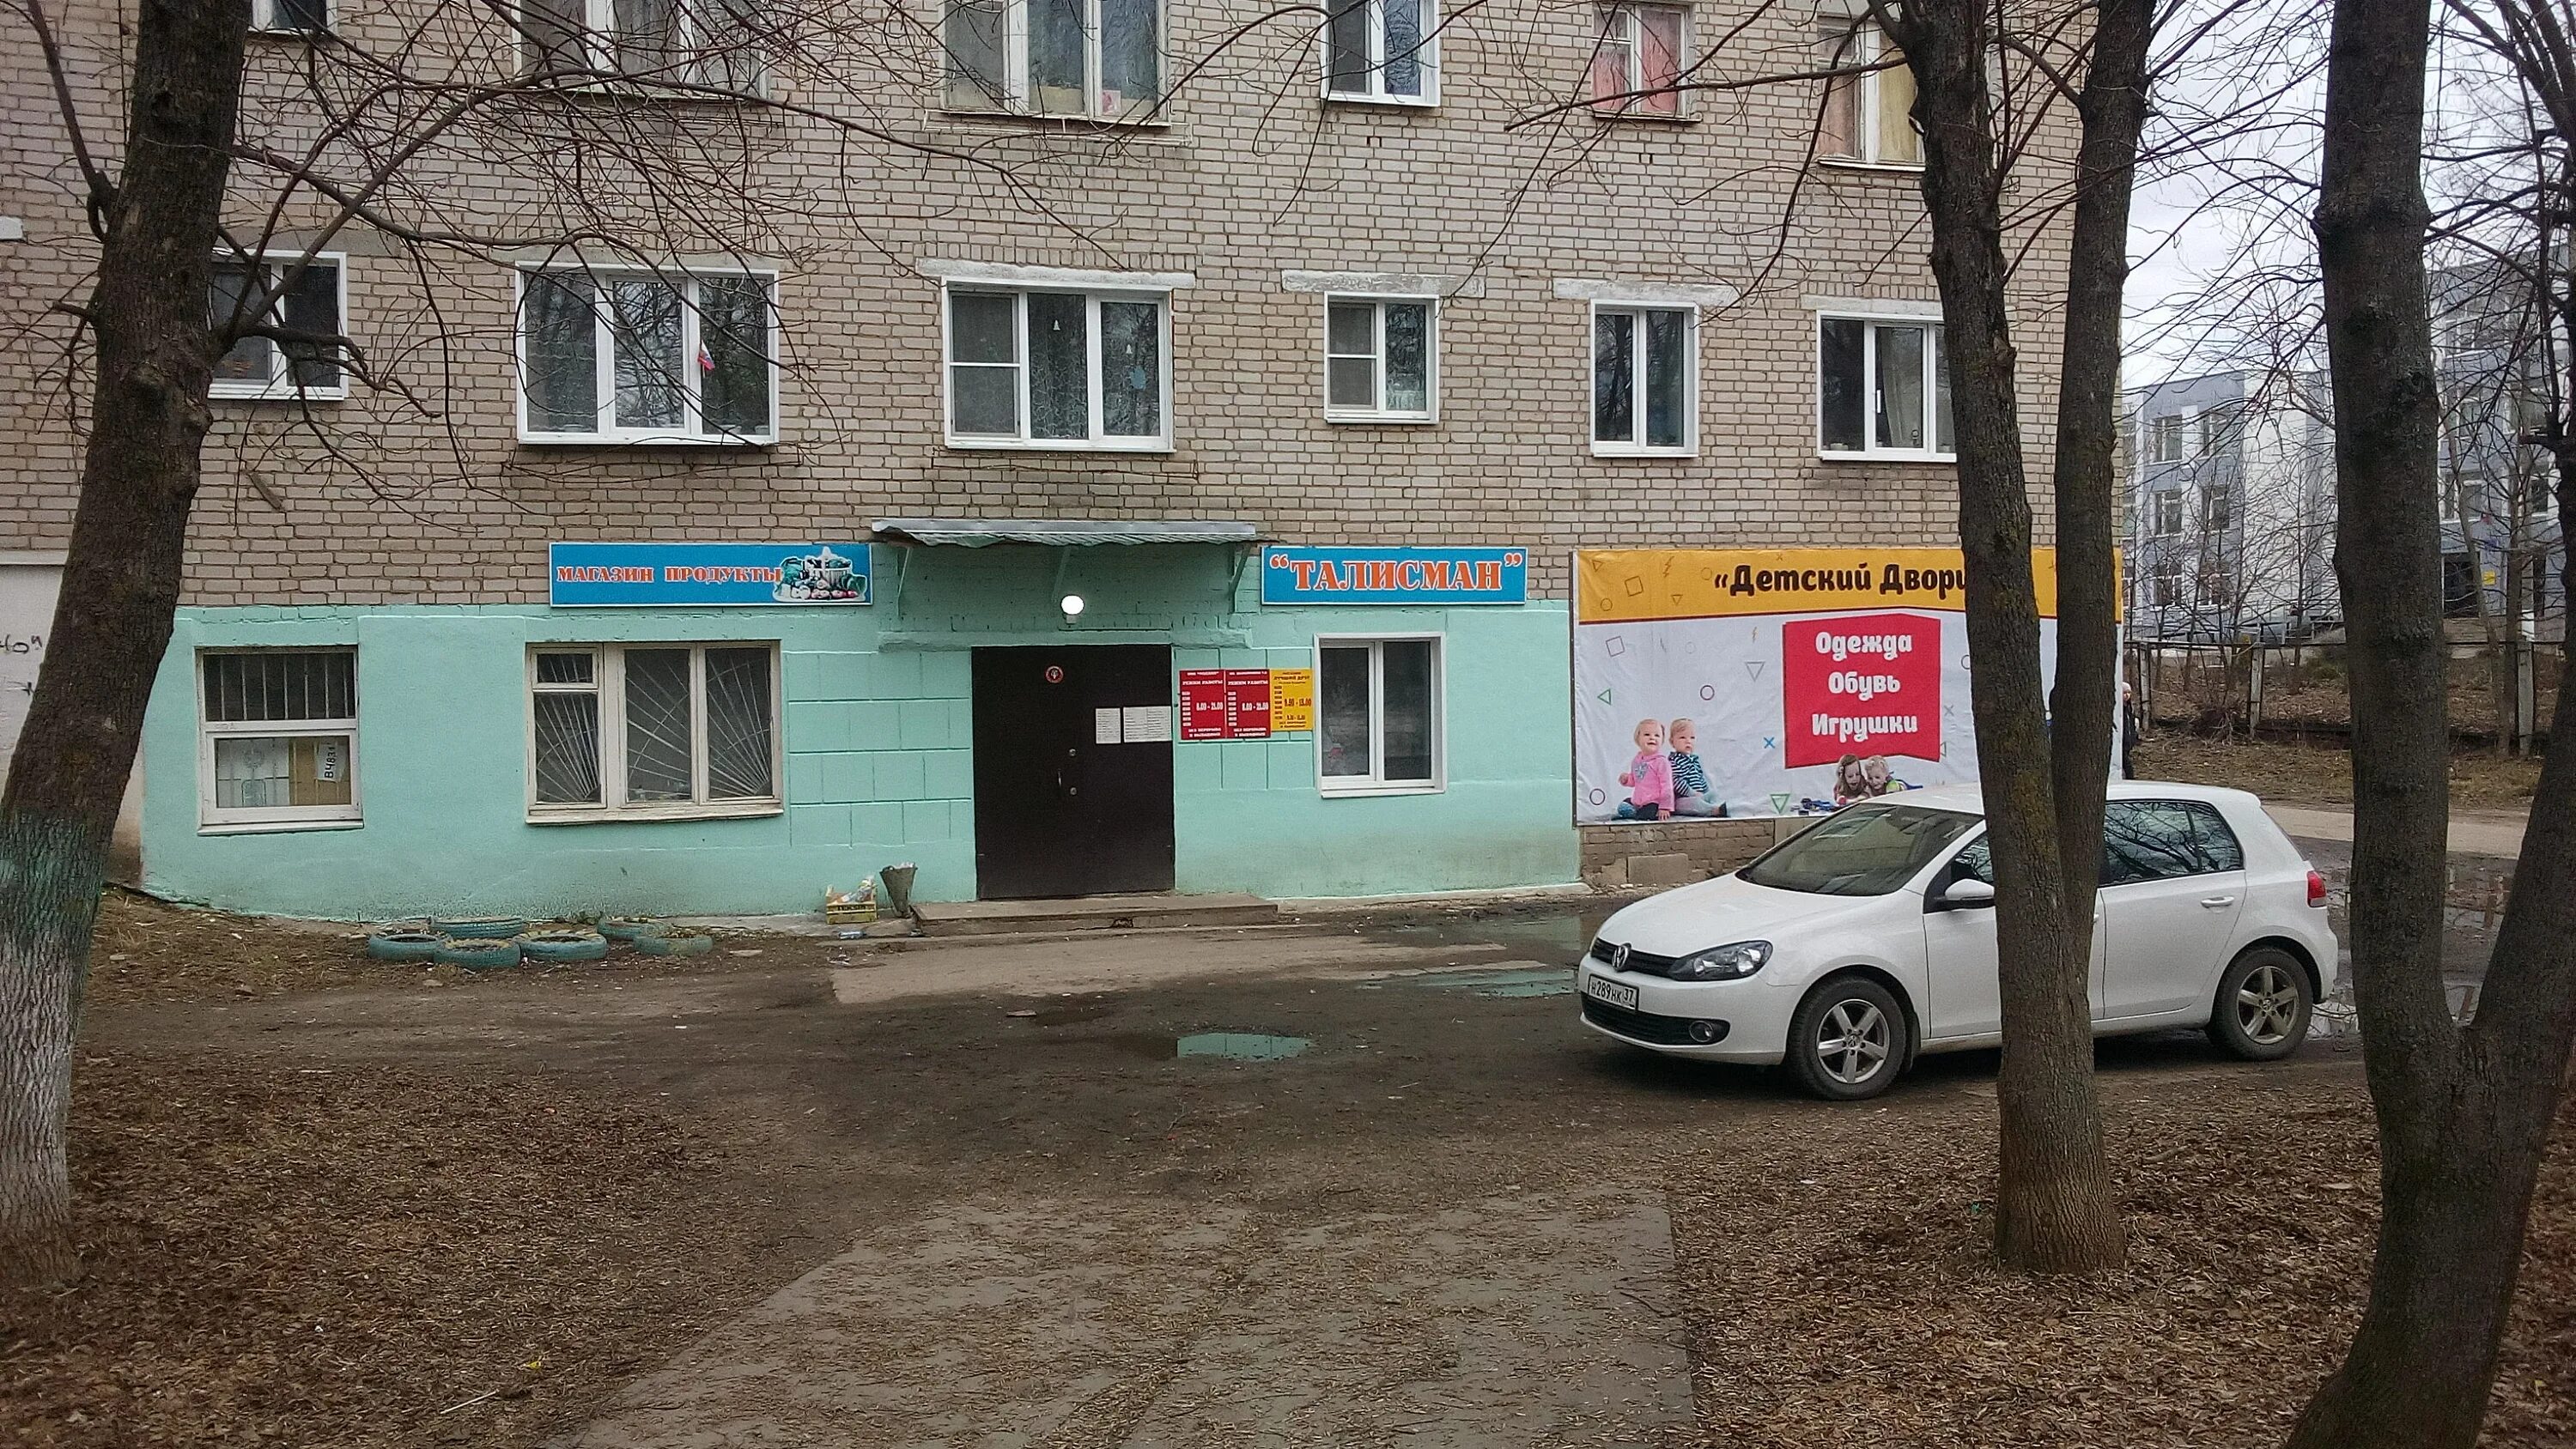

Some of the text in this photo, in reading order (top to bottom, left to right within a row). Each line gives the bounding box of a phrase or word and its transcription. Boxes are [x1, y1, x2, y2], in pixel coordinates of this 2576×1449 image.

[556, 566, 783, 585] МАГАЗИН ПРОДУКТЫ
[1714, 562, 1872, 596] «Детский
[1815, 632, 1913, 662] Одежда
[1828, 671, 1901, 701] Обувь
[1812, 713, 1918, 743] Игрушки
